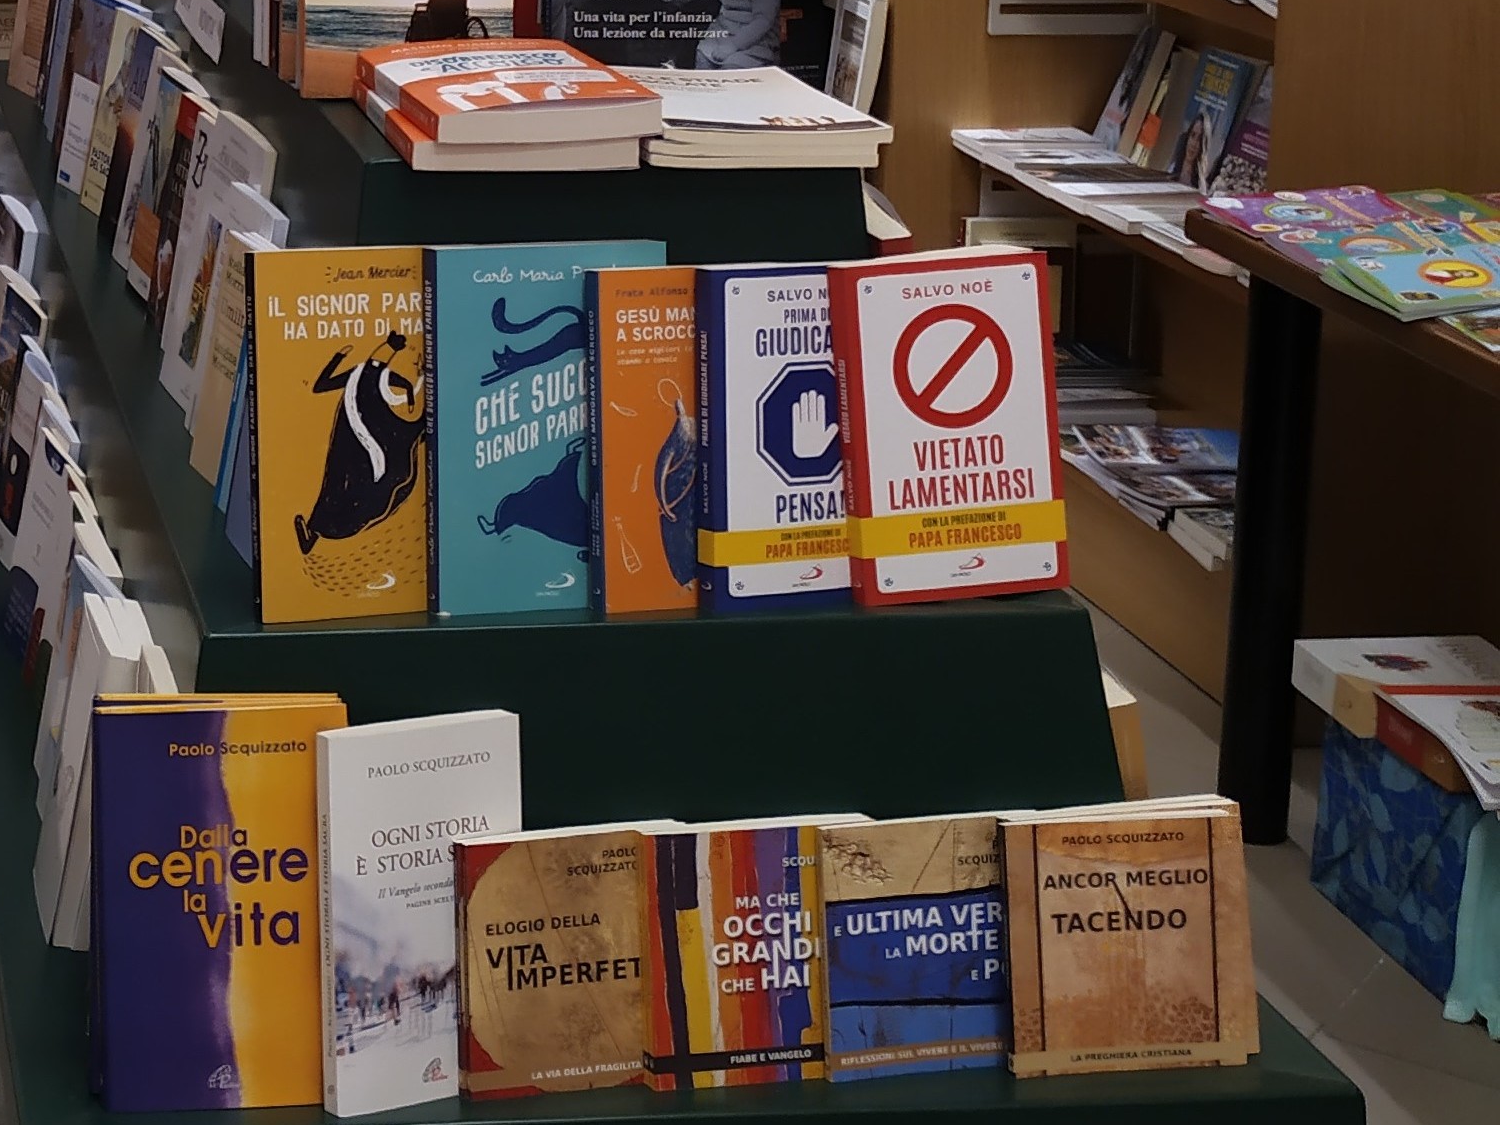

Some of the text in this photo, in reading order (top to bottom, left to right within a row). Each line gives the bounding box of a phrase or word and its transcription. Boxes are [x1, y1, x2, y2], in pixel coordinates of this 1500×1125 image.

[574, 11, 599, 23] Una
[603, 11, 626, 23] vita
[628, 13, 650, 26] per
[574, 26, 729, 39] Una lezione da realizzare
[335, 265, 412, 282] Jean Mercier
[473, 266, 565, 284] Carlo Maria
[767, 287, 814, 303] SALVO
[902, 279, 994, 301] SALVO NOÈ
[616, 304, 660, 324] GESÙ
[783, 308, 816, 324] PRIMA
[284, 319, 365, 341] HA DATO
[616, 328, 627, 342] A
[474, 381, 520, 436] CHE
[474, 420, 540, 470] SIGNOR
[913, 433, 1005, 472] VIETATO
[888, 467, 1036, 512] LAMENTARSI
[775, 489, 845, 524] PENSA!
[922, 511, 1007, 529] CON LA PREFAZIONE DI
[908, 522, 1022, 549] PAPA FRANCESCO
[765, 542, 793, 559] PAPA
[169, 739, 308, 758] Paolo Scquizzato
[367, 750, 492, 779] PAOLO SCQUIZZATO
[180, 824, 248, 851] Dalla
[371, 814, 490, 849] OGNI STORIA
[1061, 831, 1186, 846] PAOLO SCQUIZZATO
[128, 847, 309, 890] cenere
[356, 847, 444, 876] È STORIA
[1043, 867, 1209, 892] ANCOR MEGLIO
[183, 889, 207, 913] la
[389, 884, 422, 900] Vangelo
[735, 891, 801, 910] MA CHE
[197, 900, 301, 949] vita
[485, 913, 601, 937] ELOGIO DELLA
[722, 910, 813, 940] OCCHI
[833, 904, 940, 937] E ULTIMA
[1051, 908, 1188, 935] TACENDO
[885, 928, 999, 960] LA MORTE
[486, 943, 548, 973] VITA
[721, 964, 811, 994] CHE HAI
[971, 968, 979, 981] E
[729, 1048, 812, 1066] FIABE E VANGELO
[841, 1051, 896, 1067] RIFLESSIONI
[897, 1049, 915, 1061] SUL
[916, 1045, 948, 1058] VIVERE
[958, 1043, 967, 1053] IL
[1070, 1047, 1193, 1063] LA PREGHIERA CRISTIANA
[531, 1066, 593, 1081] LA VIA DELLA
